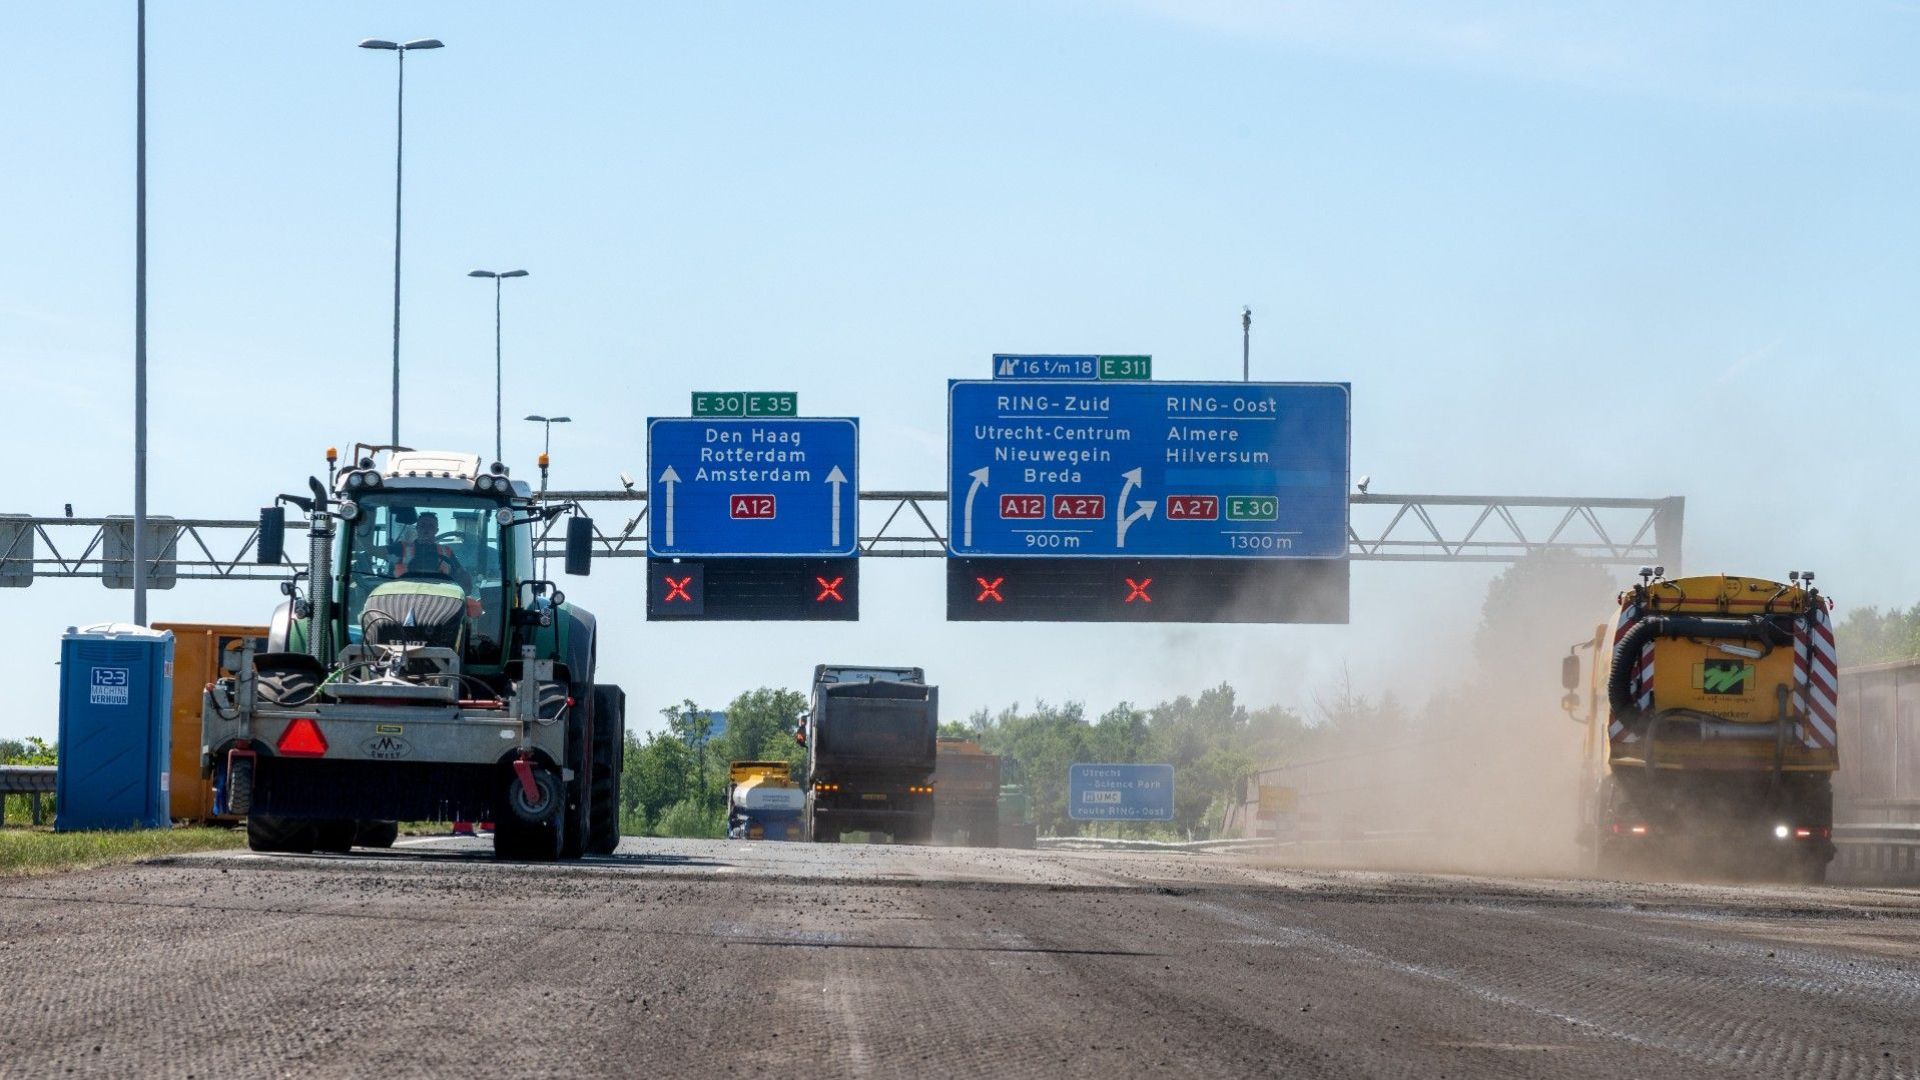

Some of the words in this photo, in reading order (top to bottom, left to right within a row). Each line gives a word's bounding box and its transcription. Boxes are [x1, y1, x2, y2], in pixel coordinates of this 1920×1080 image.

[1023, 361, 1039, 373] 16
[1044, 360, 1070, 373] t/m
[1075, 361, 1091, 373] 18
[1105, 361, 1115, 374] E
[1121, 361, 1146, 375] 311
[697, 398, 707, 411] E
[714, 397, 738, 411] 30
[751, 398, 760, 411] E
[768, 398, 791, 411] 35
[998, 396, 1109, 411] RING-Zuid
[1167, 397, 1276, 412] RING-Oost
[707, 429, 741, 442] Den
[752, 429, 800, 446] Haag
[975, 426, 1130, 440] Utrecht-Centrum
[1167, 427, 1238, 441] Almere
[701, 448, 805, 462] Rotterdam
[996, 447, 1110, 465] Nieuwegein
[1167, 448, 1268, 463] Hilversum
[696, 468, 810, 481] Amsterdam
[1025, 469, 1081, 482] Breda
[736, 500, 771, 514] A12
[1006, 500, 1041, 514] A12
[1233, 501, 1243, 515] E
[1249, 502, 1273, 515] 30
[1026, 535, 1060, 547] 900
[1065, 537, 1079, 547] m
[1231, 536, 1272, 549] 1300
[1277, 538, 1291, 548] m
[92, 695, 127, 704] VERHUUR
[1082, 769, 1121, 777] Utrecht
[1137, 780, 1161, 790] Park
[1096, 793, 1118, 801] UMC
[1078, 806, 1105, 815] route
[1108, 806, 1164, 816] RING-Oost
